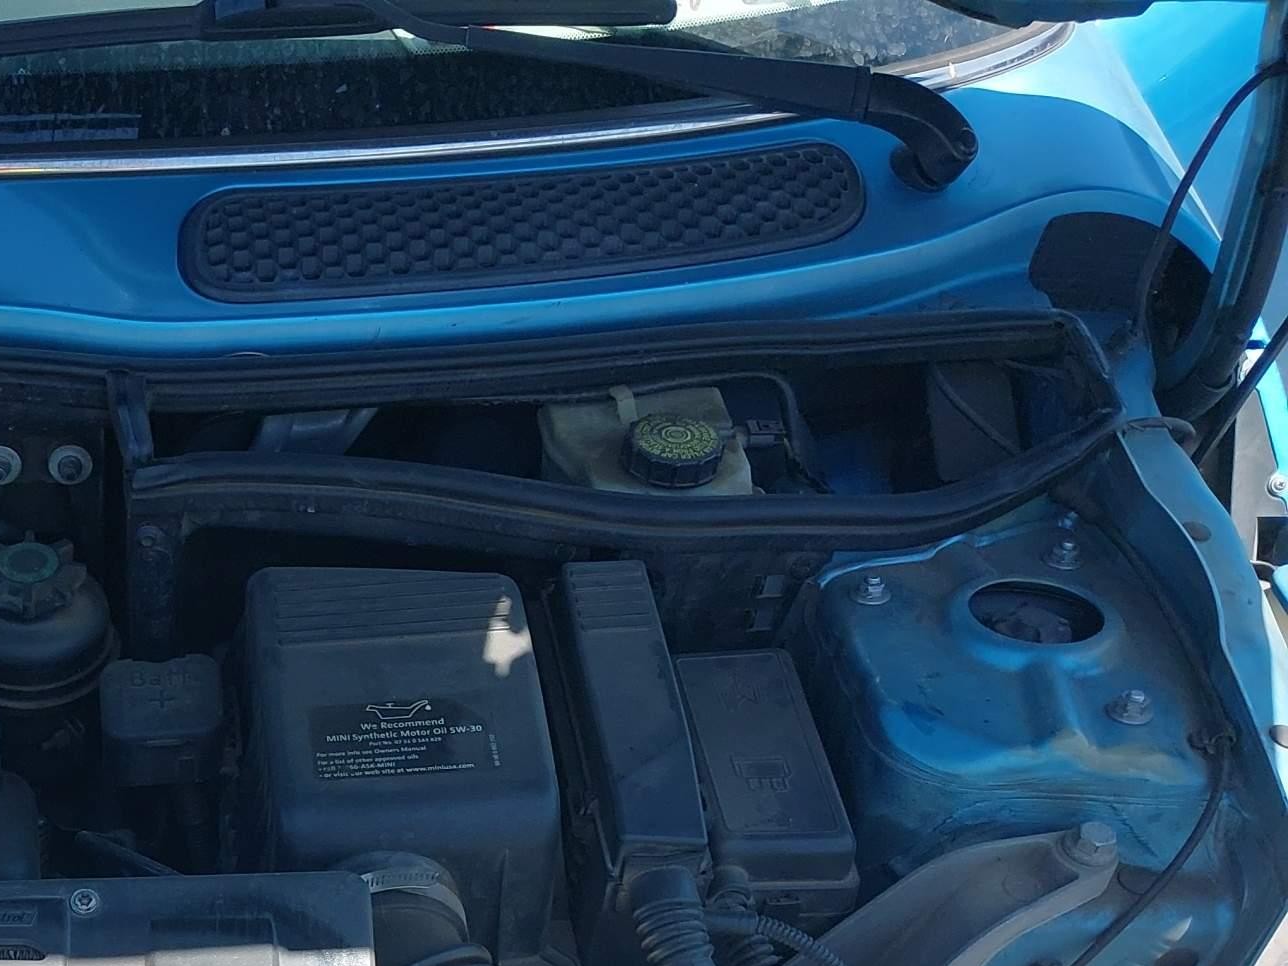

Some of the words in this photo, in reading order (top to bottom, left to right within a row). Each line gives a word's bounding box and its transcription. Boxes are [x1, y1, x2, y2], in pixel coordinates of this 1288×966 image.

[360, 722, 378, 731] We
[380, 717, 445, 729] Recommend
[326, 734, 351, 743] MINI
[352, 730, 398, 742] Synthetic
[400, 729, 431, 738] Motor
[433, 726, 448, 735] Oil
[449, 724, 483, 734] 5W-30
